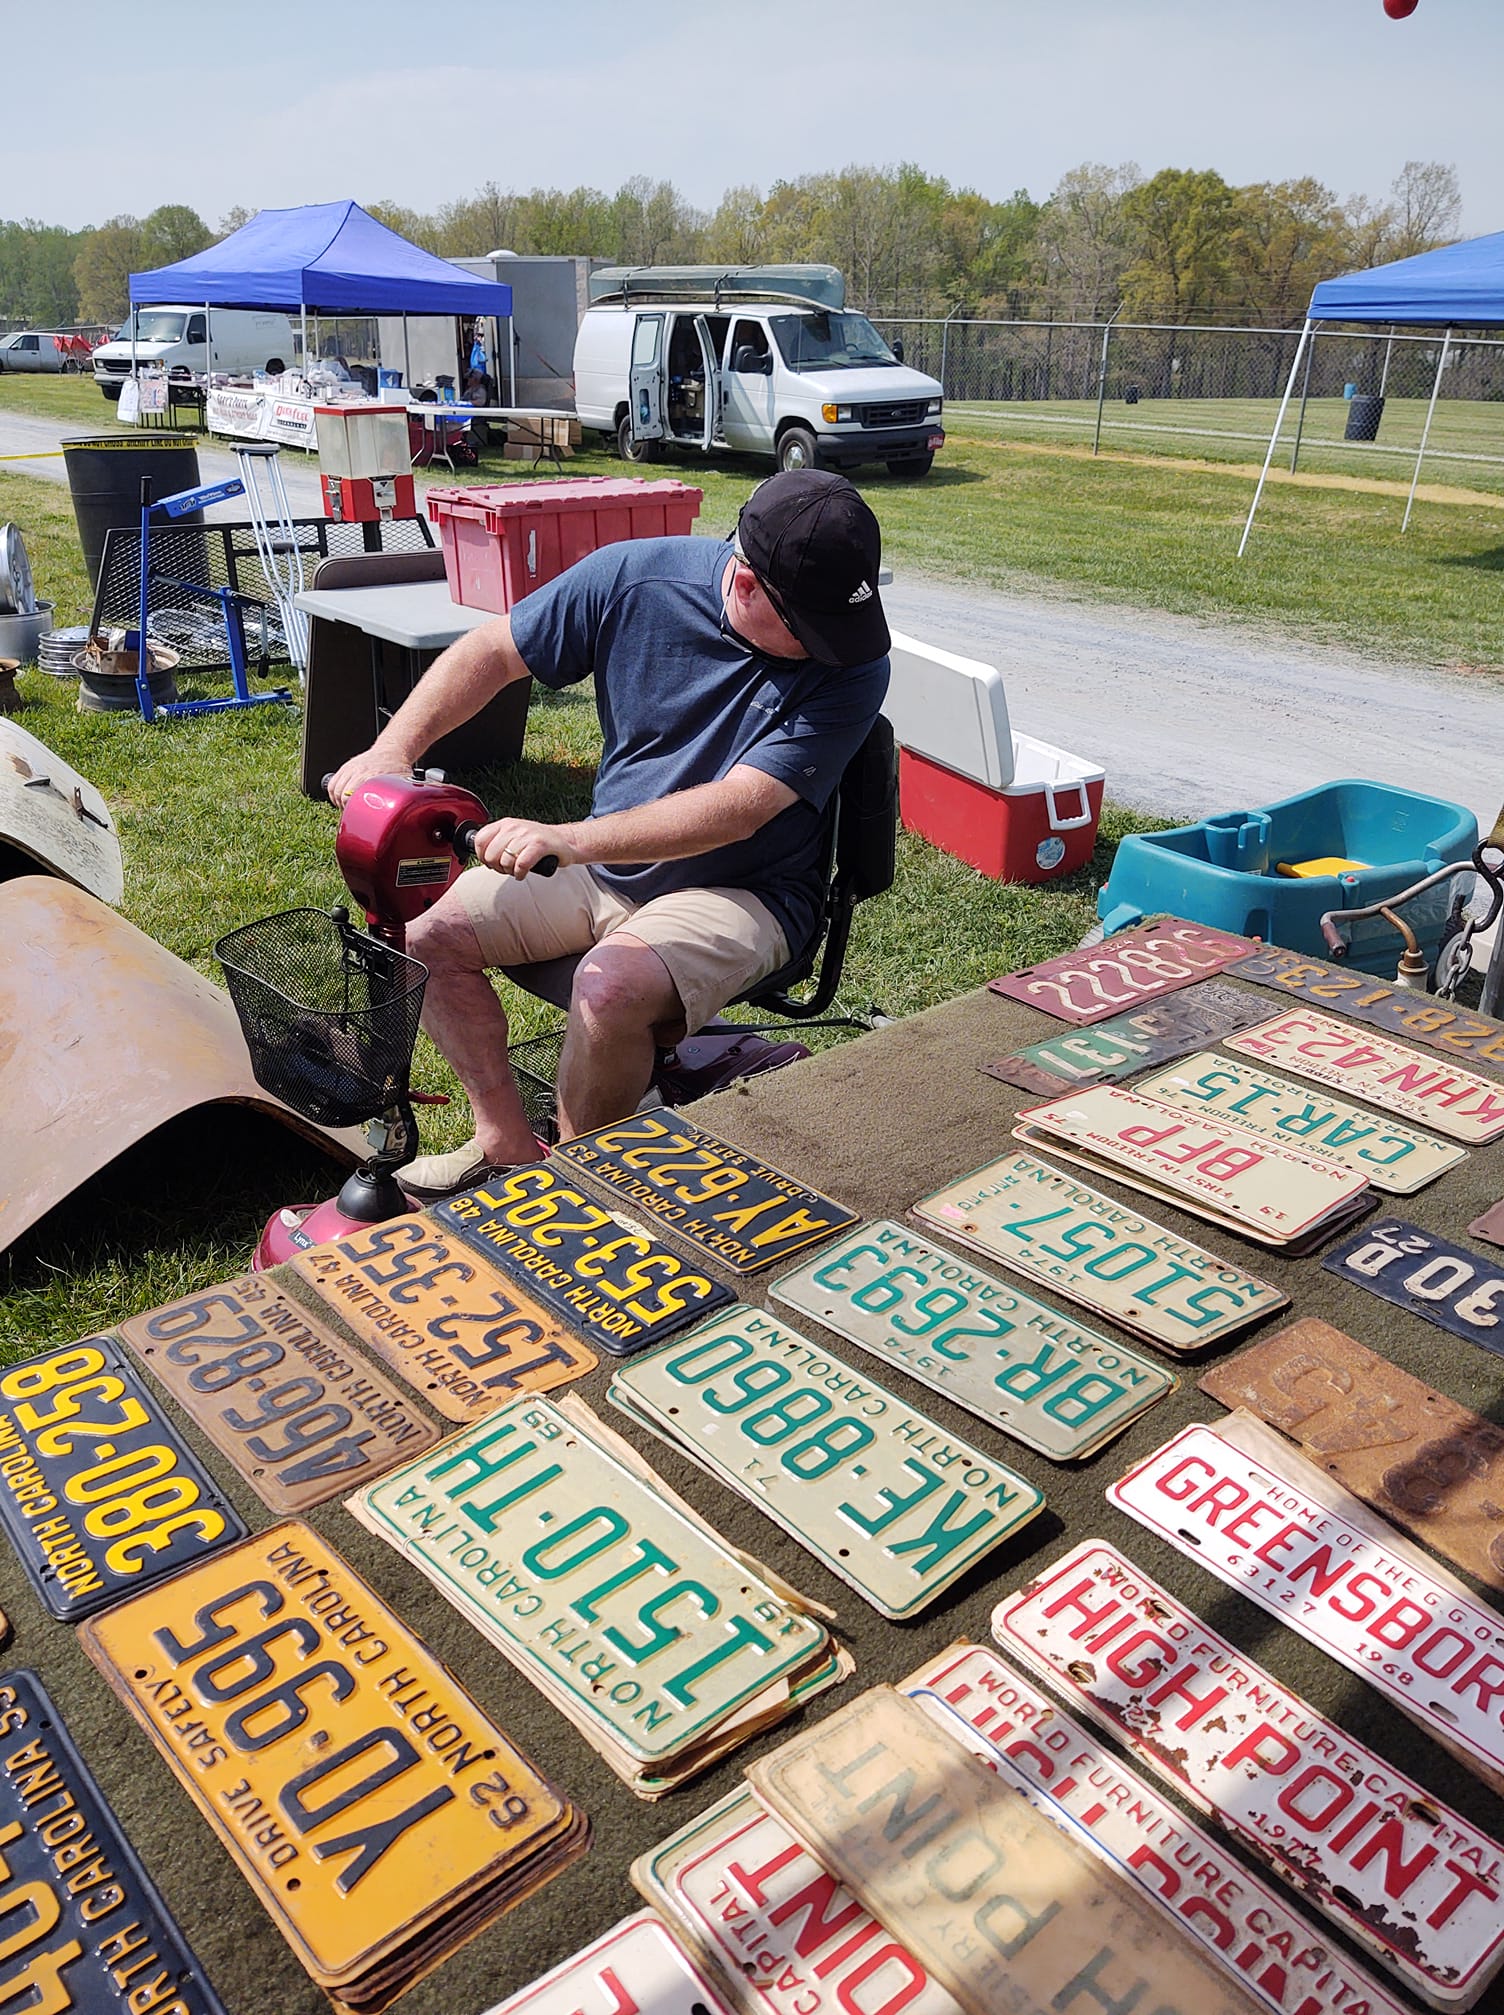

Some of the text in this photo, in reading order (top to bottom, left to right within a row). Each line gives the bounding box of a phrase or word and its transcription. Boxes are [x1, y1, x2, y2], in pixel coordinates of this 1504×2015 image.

[848, 590, 873, 604] adidas
[1212, 1058, 1335, 1107] CAROLINA
[1306, 1014, 1420, 1062] CAROLINA
[692, 1135, 802, 1198] DRIVE SAFELY
[1043, 1112, 1068, 1123] 75
[1085, 1131, 1234, 1199] FIRST IN FREEDOM
[1109, 1090, 1348, 1181] NORTH CAROLINA
[1117, 1123, 1265, 1182] BFP
[1197, 1105, 1345, 1162] FIRST IN FREEDOM
[1352, 1111, 1448, 1151] NORTH
[294, 1232, 309, 1248] Lynx
[565, 1144, 756, 1265] NORTH CAROLINA 63
[1011, 1158, 1264, 1297] NORTH CAROLINA
[1258, 1205, 1289, 1221] 19
[1371, 1225, 1431, 1254] 27
[448, 1198, 642, 1339] NORTH CAROLINA 48
[873, 1227, 1149, 1388] NORTH CAROLINA
[1018, 1249, 1081, 1283] 1974
[228, 1279, 422, 1446] NORTH CAROLINA 45
[307, 1254, 492, 1408] NORTH CAROLINA 47
[882, 1335, 954, 1376] 1974
[743, 1318, 1017, 1507] NORTH CAROLINA
[740, 1457, 779, 1490] 71
[31, 1514, 104, 1600] NORTH
[1155, 1455, 1504, 1725] GREENSBOR
[1267, 1486, 1330, 1535] HOME
[1336, 1534, 1365, 1557] OF
[1373, 1557, 1421, 1593] THE
[266, 1541, 485, 1777] NORTH CAROLINA
[391, 1484, 673, 1734] NORTH CAROLINA
[1226, 1554, 1416, 1687] 63127 1968
[149, 1680, 302, 1871] DRIVE SAFELY
[1043, 1578, 1231, 1732] HIGH
[1221, 1721, 1502, 1933] POINT
[1097, 1562, 1191, 1643] WORLD
[1191, 1642, 1370, 1771] FURNITURE
[1364, 1773, 1504, 1884] CAITAL
[4, 1737, 126, 1929] CAROLINA
[464, 1773, 531, 1833] 62
[813, 1740, 1063, 1962] POINT
[977, 1670, 1071, 1753] WORLD
[1070, 1754, 1244, 1900] FURNITURE
[1245, 1906, 1375, 2015] CAPITA
[709, 1879, 822, 2015] CAPITAL
[724, 1842, 928, 2015] OINT
